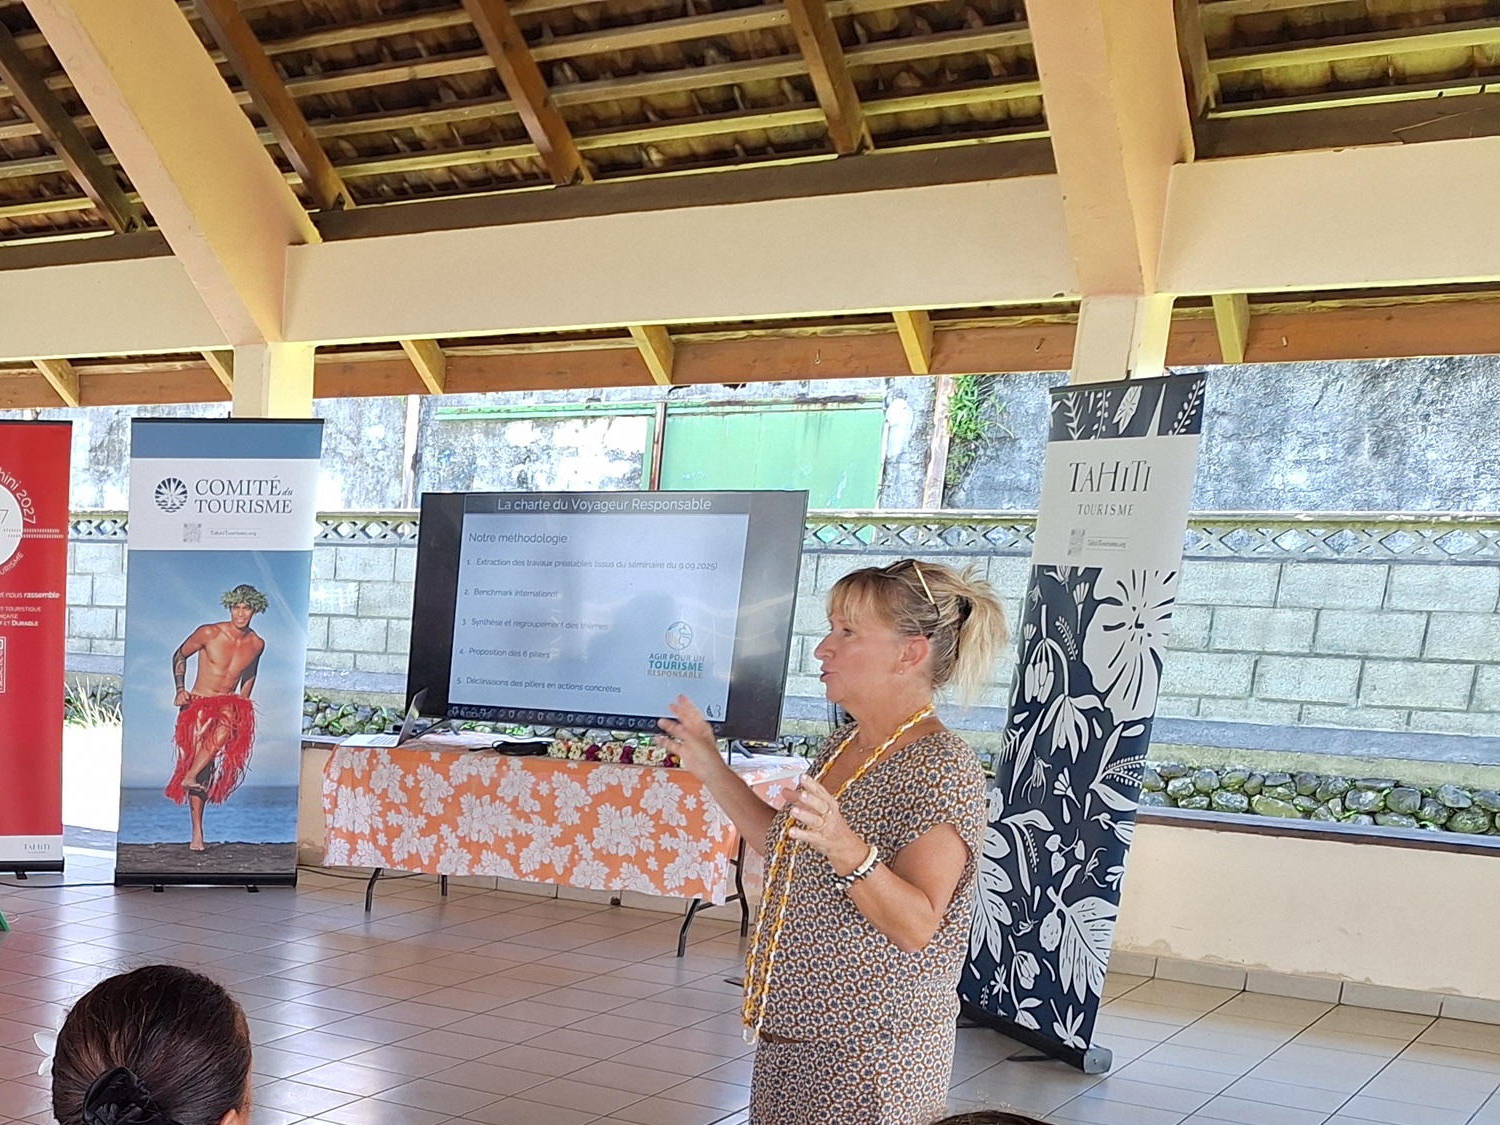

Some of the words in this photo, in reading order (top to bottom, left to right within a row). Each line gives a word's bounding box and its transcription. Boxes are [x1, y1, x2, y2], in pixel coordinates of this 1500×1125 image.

[1069, 460, 1152, 492] TAHITI
[195, 475, 281, 496] COMITÉ
[282, 487, 293, 496] du
[16, 489, 36, 525] 2027
[195, 499, 292, 514] TOURISME
[498, 499, 511, 510] La
[513, 498, 550, 510] charte
[552, 498, 568, 510] du
[571, 498, 628, 513] Voyageur
[632, 498, 712, 512] Responsable
[1077, 503, 1135, 516] TOURISME
[468, 533, 496, 543] Notre
[498, 533, 568, 546] méthodologie
[476, 558, 511, 566] Extraction
[512, 559, 525, 567] des
[554, 559, 592, 568] préalables
[628, 561, 665, 569] séminaire
[666, 561, 677, 569] du
[23, 591, 60, 599] rassemble
[473, 588, 513, 597] Benchmark
[504, 619, 511, 627] et
[565, 621, 579, 630] des
[469, 648, 507, 657] Proposition
[508, 649, 521, 658] des
[648, 652, 668, 660] AGIR
[669, 653, 691, 662] POUR
[648, 660, 704, 672] TOURISME
[647, 669, 703, 679] RESPONSABLE
[466, 677, 509, 687] Déclinaisons
[509, 679, 523, 688] des
[524, 680, 545, 689] piliers
[557, 683, 583, 691] actions
